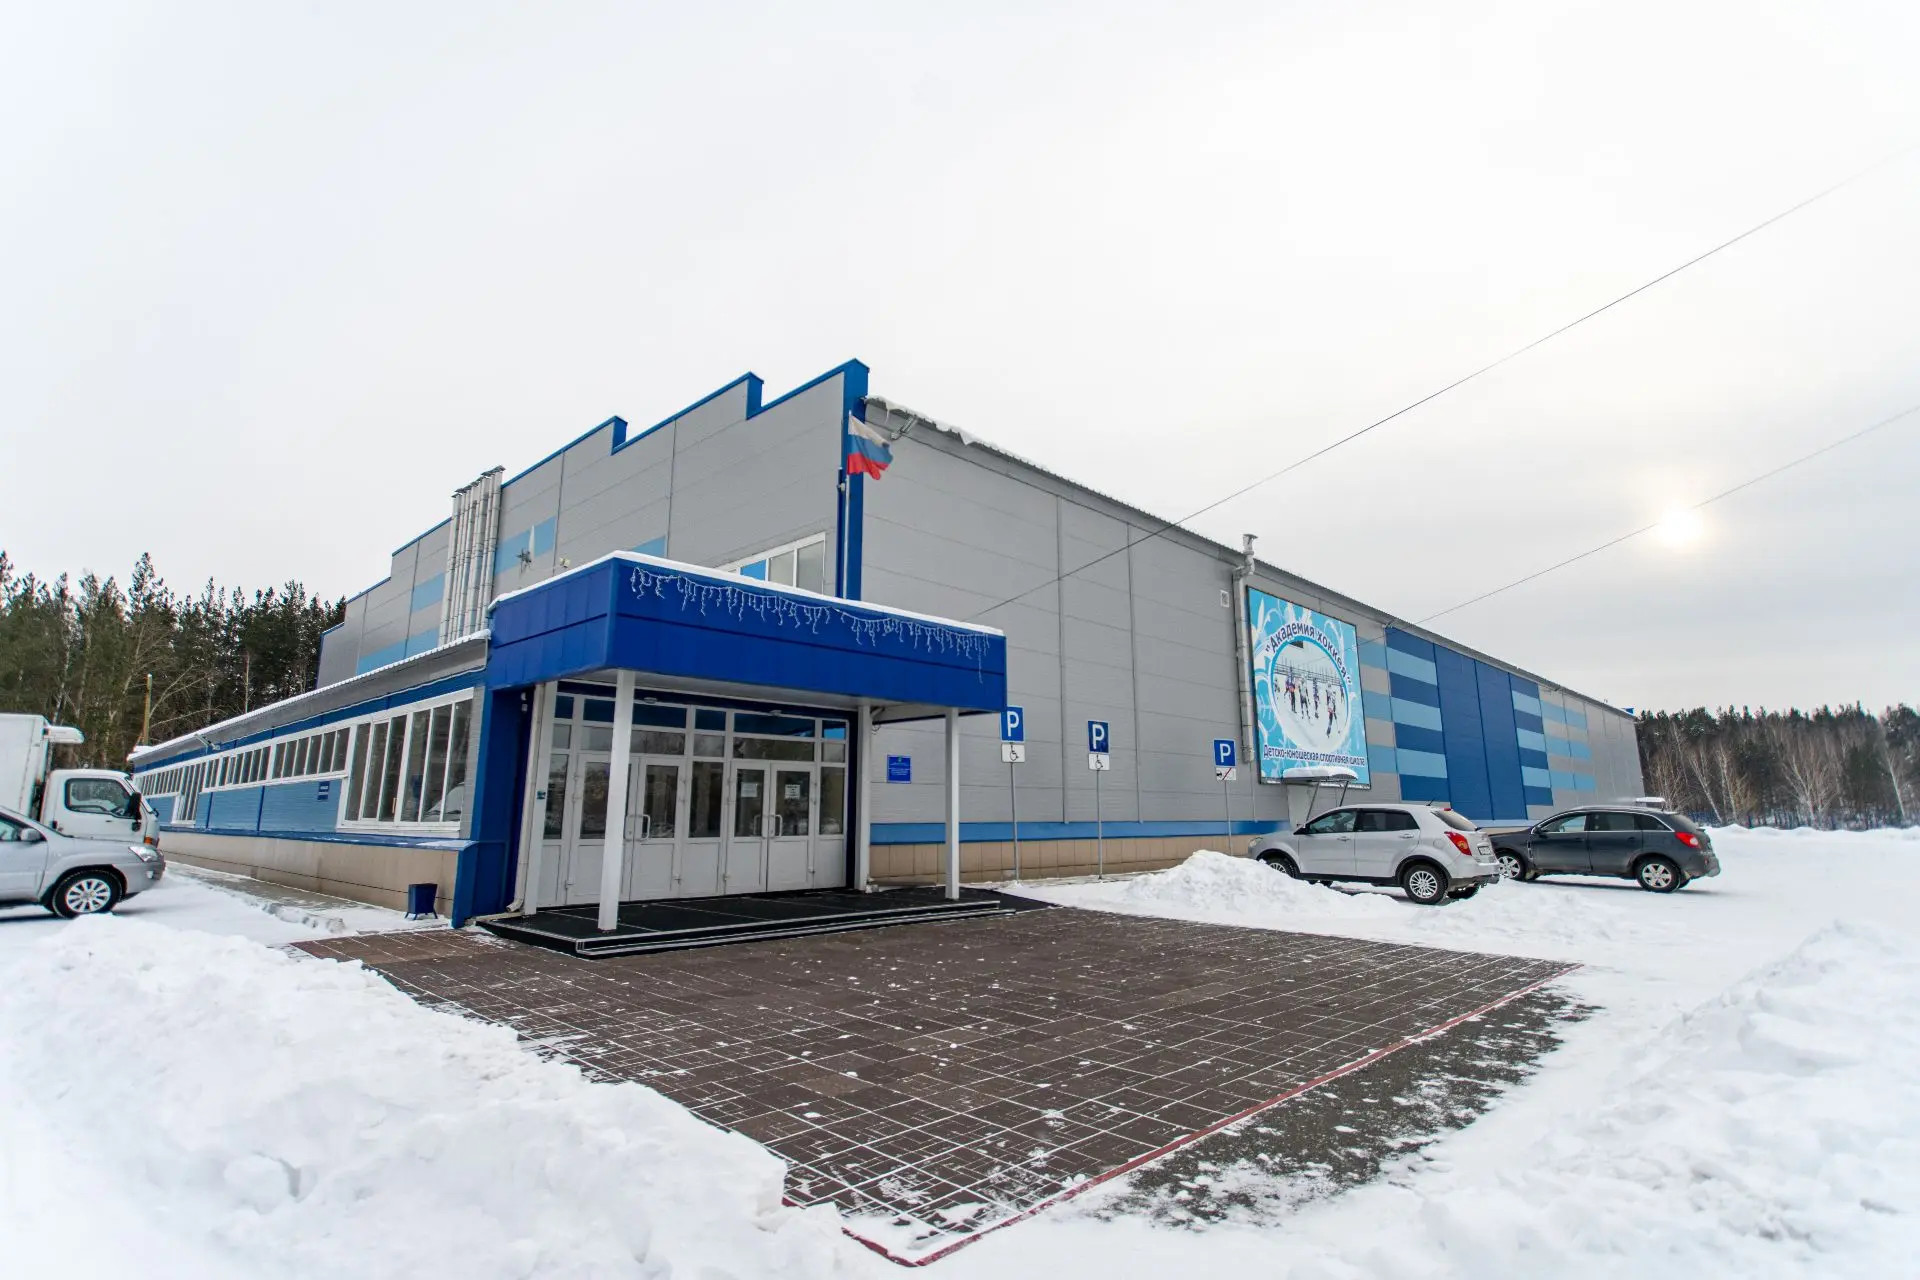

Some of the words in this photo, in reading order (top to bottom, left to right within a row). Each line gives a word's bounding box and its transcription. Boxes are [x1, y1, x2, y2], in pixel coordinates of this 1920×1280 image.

[1007, 710, 1019, 737] P
[1092, 723, 1105, 750] P
[1220, 743, 1231, 763] P
